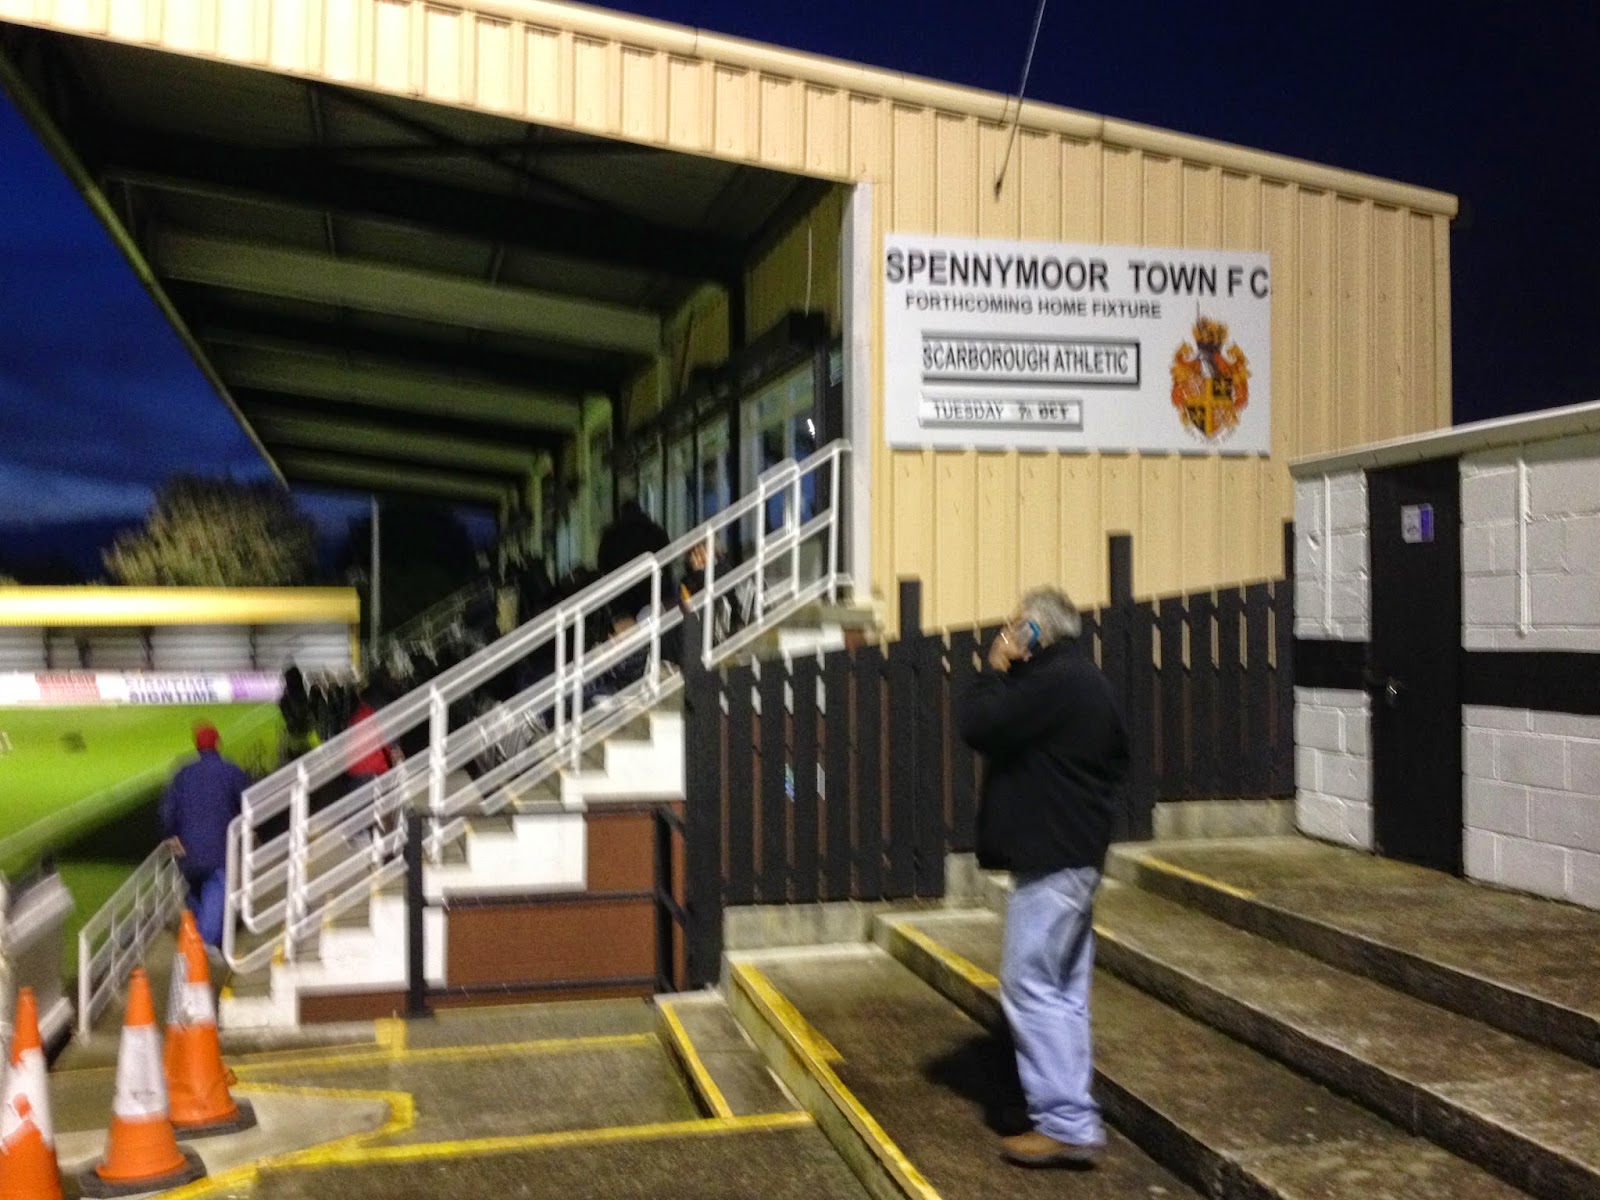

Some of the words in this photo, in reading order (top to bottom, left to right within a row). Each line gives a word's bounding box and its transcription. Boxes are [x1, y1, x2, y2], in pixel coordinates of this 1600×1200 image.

[886, 247, 1110, 293] SPENNYMOOR
[1128, 259, 1217, 297] TOWN
[905, 290, 1033, 315] FORTHCOMING
[1038, 295, 1087, 317] HOME
[1092, 299, 1162, 319] FIXTURE
[923, 341, 1050, 372] SCARBOROUGH
[1053, 346, 1129, 375] ATHLETIC
[934, 401, 1004, 420] TUESDAY
